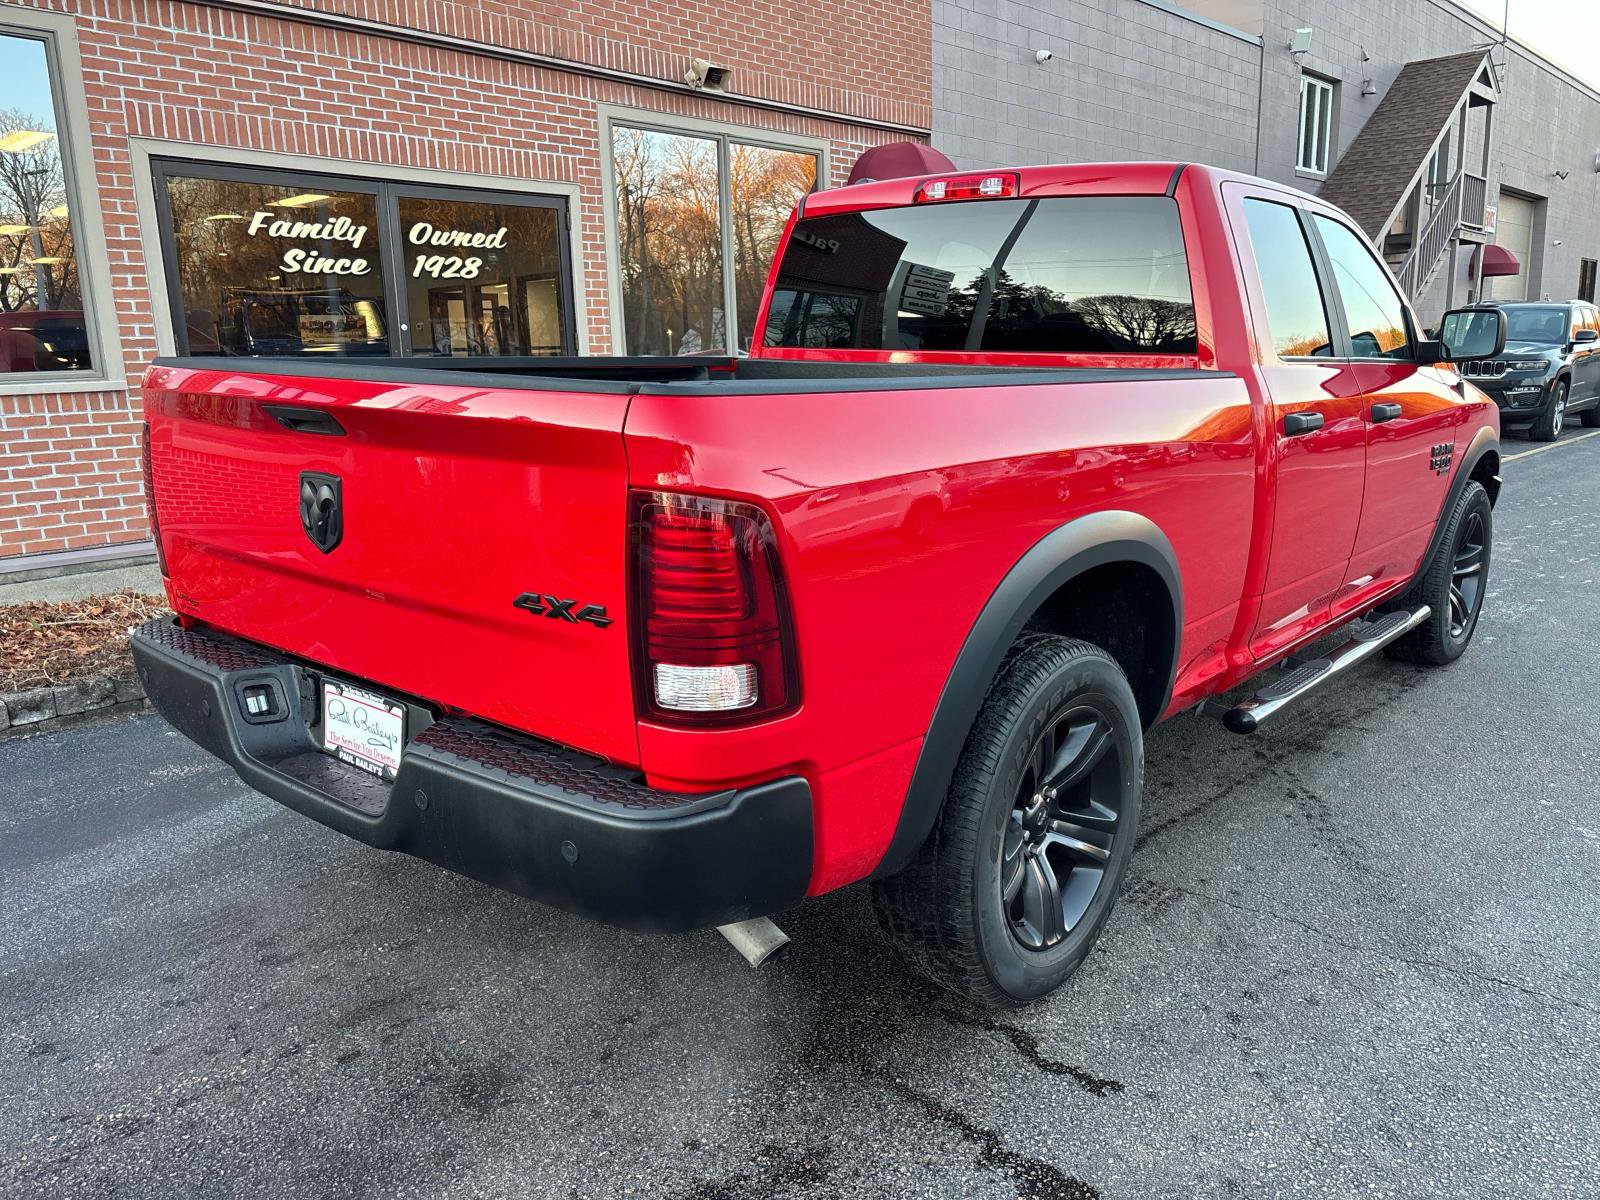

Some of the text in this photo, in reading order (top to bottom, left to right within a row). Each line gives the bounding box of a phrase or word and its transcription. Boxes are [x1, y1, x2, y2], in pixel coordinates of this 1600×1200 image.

[248, 211, 507, 249] Family Owned
[279, 249, 483, 279] Since 1928
